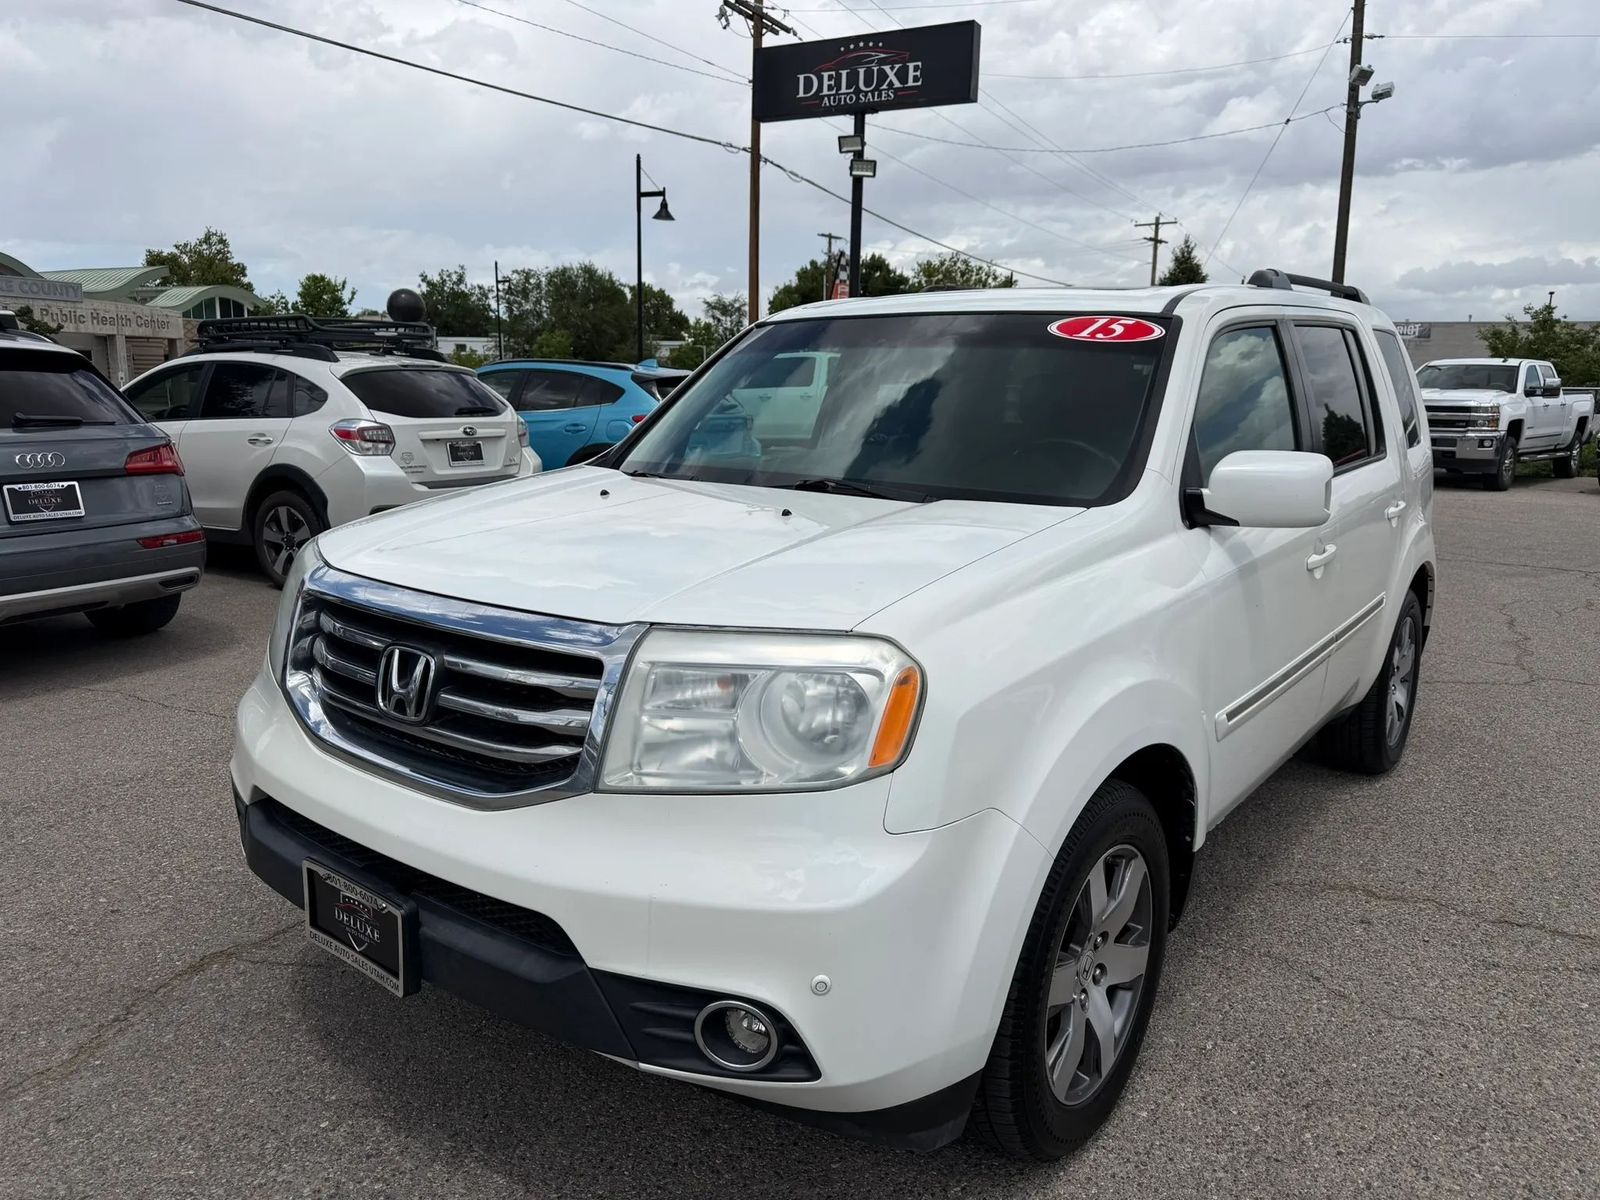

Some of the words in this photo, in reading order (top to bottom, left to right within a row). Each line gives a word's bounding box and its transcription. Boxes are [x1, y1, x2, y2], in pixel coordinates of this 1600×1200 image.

[796, 61, 923, 98] DELUXE
[821, 93, 856, 107] AUTO
[858, 89, 895, 104] SALES
[18, 280, 80, 298] COUNTY
[40, 308, 86, 325] Public
[90, 311, 131, 328] Health
[135, 315, 170, 331] Center
[1072, 318, 1137, 338] 15
[28, 497, 62, 505] DELUXE
[335, 907, 381, 943] DELUXE
[309, 931, 334, 949] DELUXE
